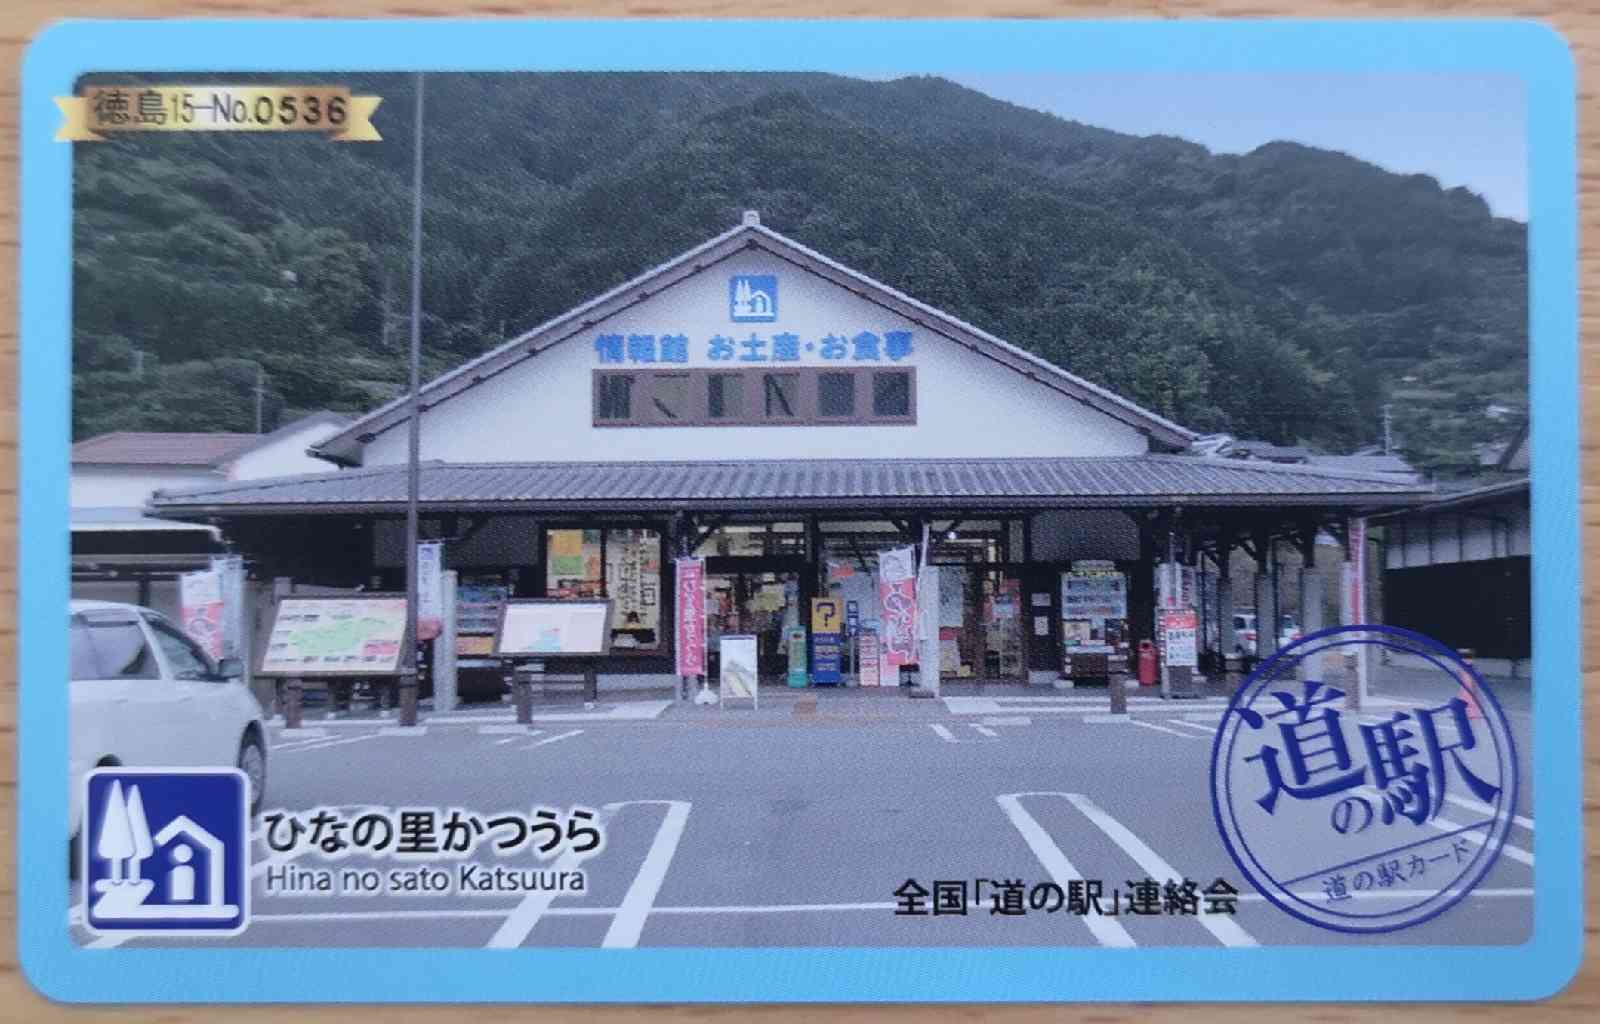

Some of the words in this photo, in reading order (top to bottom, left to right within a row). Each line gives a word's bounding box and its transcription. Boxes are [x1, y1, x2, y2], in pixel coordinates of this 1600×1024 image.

[594, 333, 689, 363] 情報館
[1231, 680, 1503, 835] 道の駅
[263, 810, 602, 853] ひなの里かつうら
[267, 866, 332, 891] Hina
[343, 872, 379, 891] no
[390, 868, 449, 891] sato
[459, 865, 585, 891] Katsuura
[1322, 839, 1471, 904] 道の駅カード
[893, 877, 1239, 917] 全国「道の駅」連絡会
